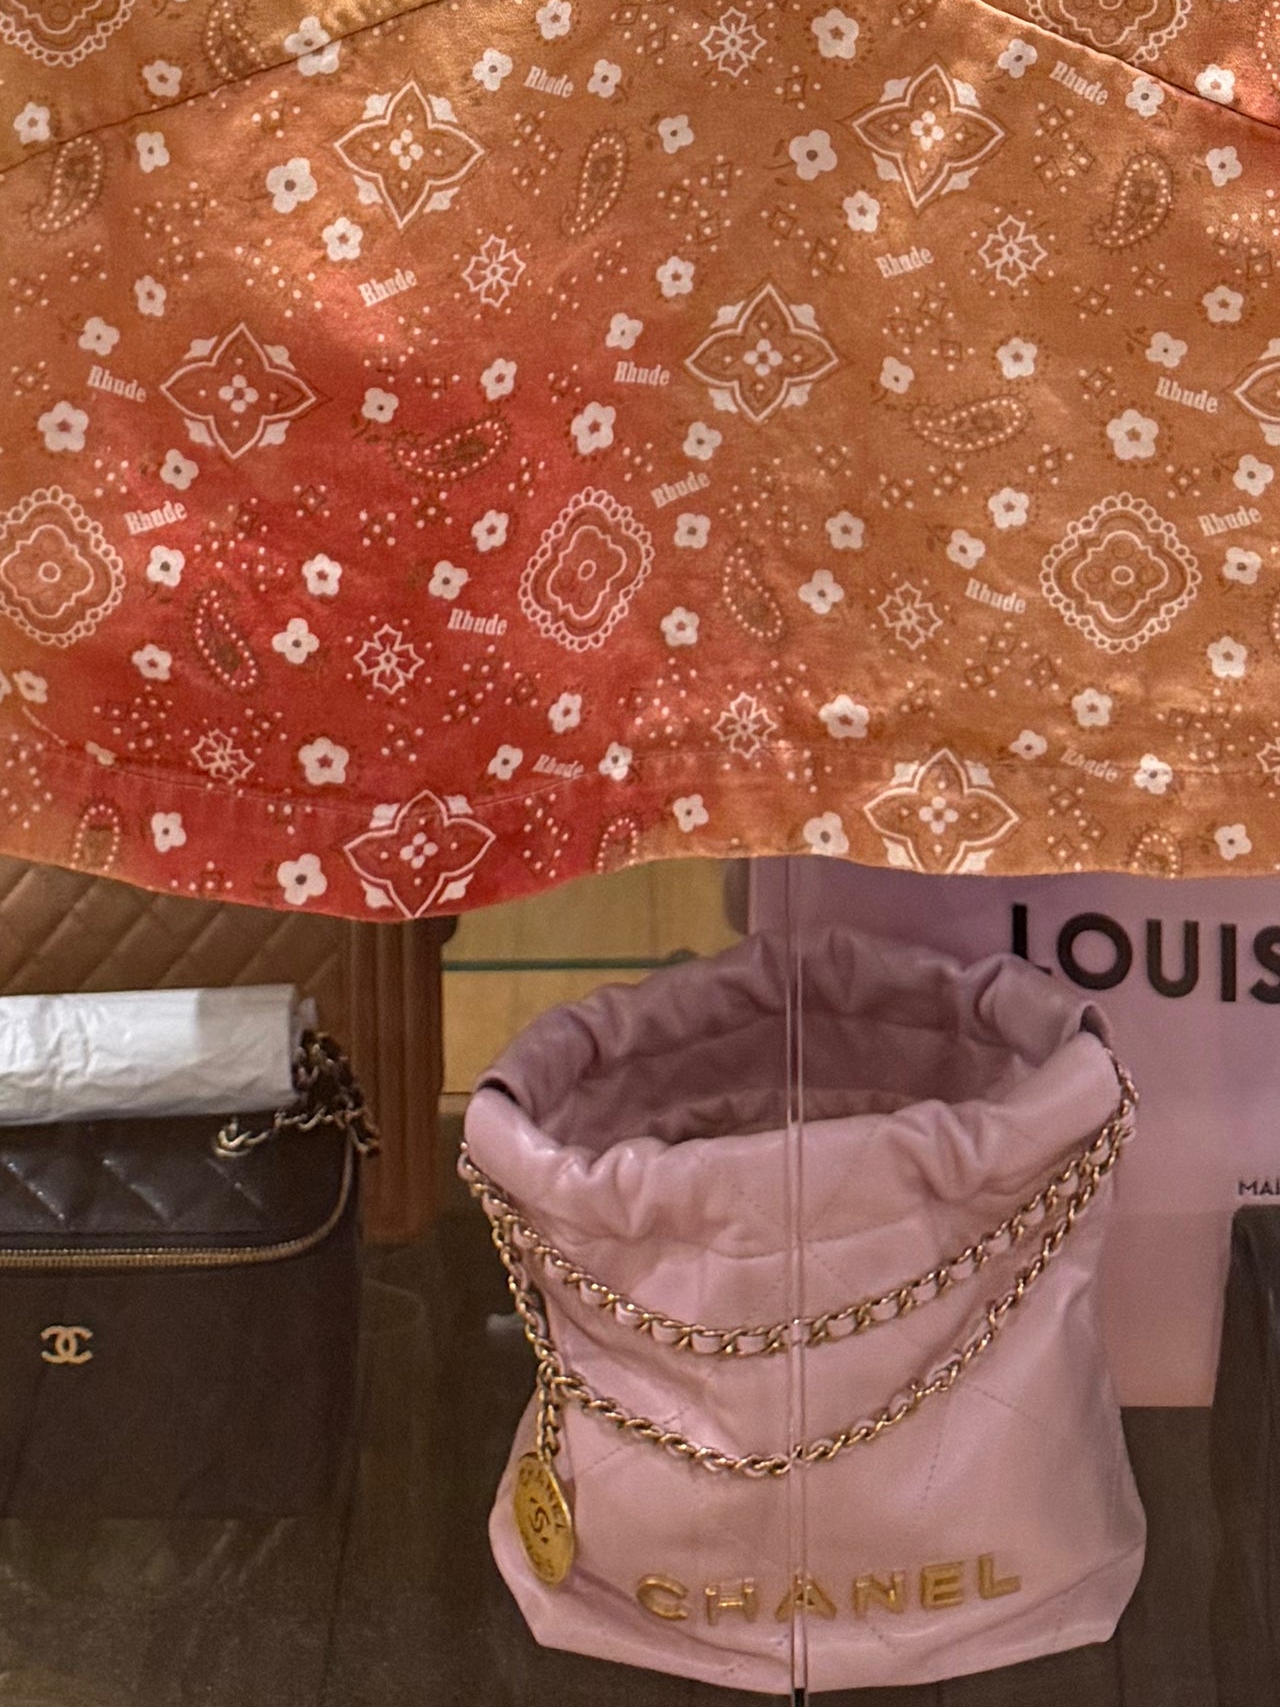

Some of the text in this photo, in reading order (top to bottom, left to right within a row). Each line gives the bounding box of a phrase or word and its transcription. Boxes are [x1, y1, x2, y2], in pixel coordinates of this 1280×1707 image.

[525, 66, 574, 98] Rhude
[1050, 58, 1110, 104] Rhude
[877, 239, 935, 278] Rhude
[358, 269, 418, 306] Rhude
[87, 366, 148, 403] Rhude
[613, 361, 672, 388] Rhude
[1155, 378, 1218, 414] Rhude
[651, 471, 711, 507] Rhude
[126, 499, 188, 536] Rhude
[1198, 502, 1263, 537] Rhude
[965, 576, 1027, 613] Rhude
[447, 609, 508, 637] Rhude
[533, 754, 583, 779] Rhude
[636, 1552, 1021, 1627] CHANEL
